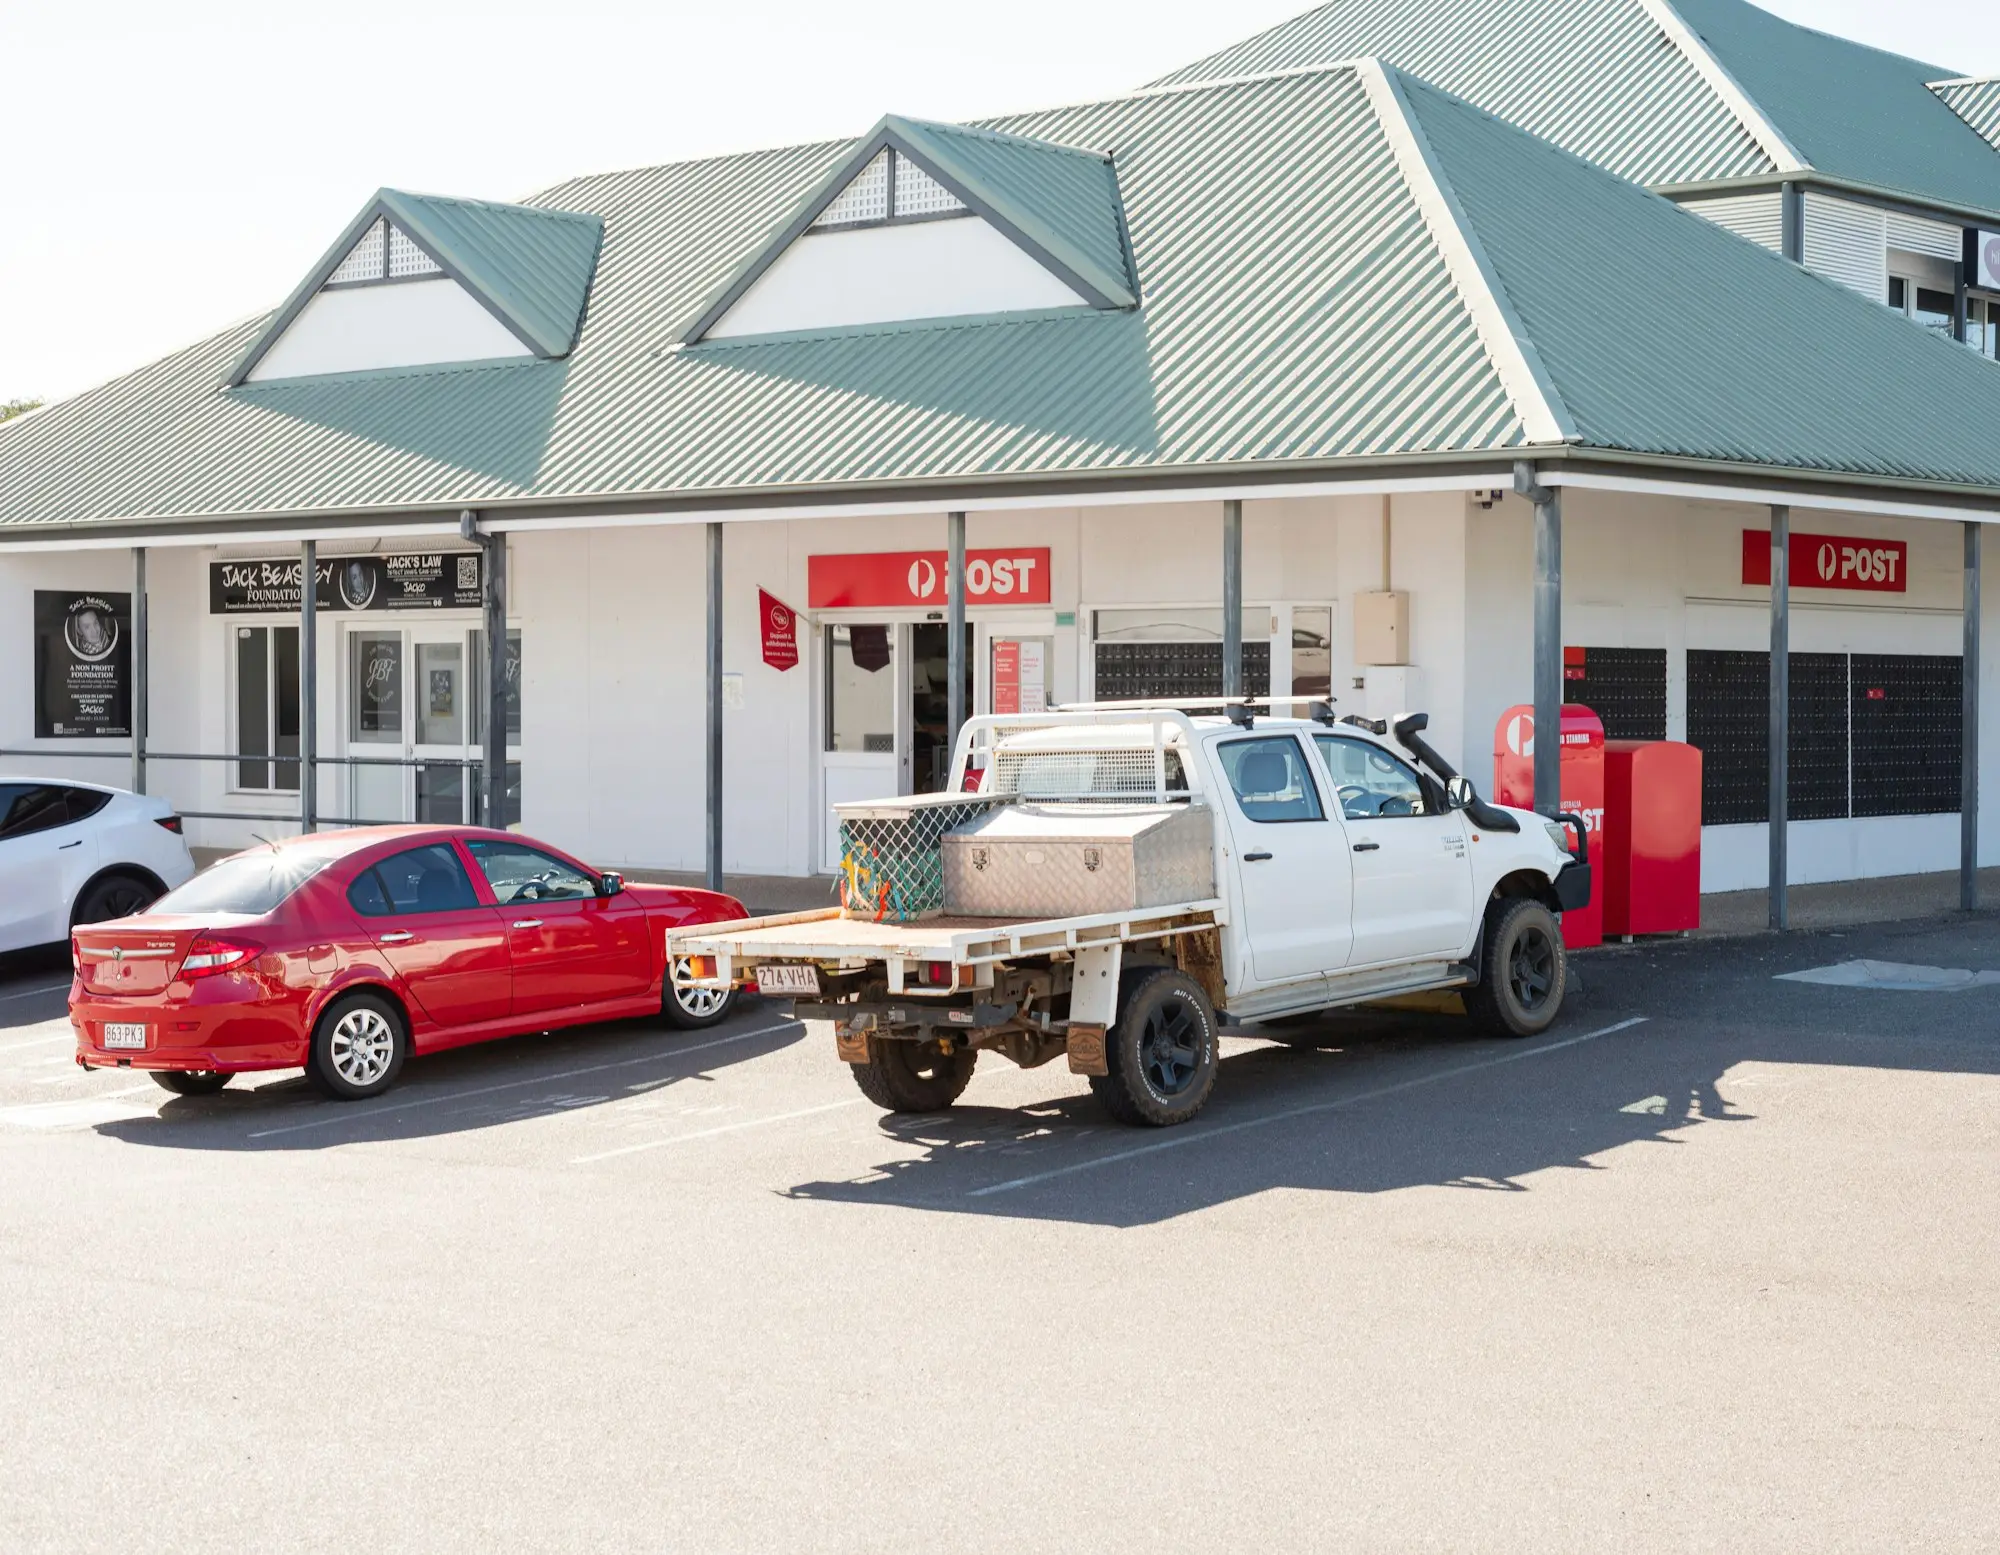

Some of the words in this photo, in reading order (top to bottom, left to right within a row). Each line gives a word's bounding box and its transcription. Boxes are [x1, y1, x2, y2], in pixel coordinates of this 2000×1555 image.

[386, 556, 420, 569] JACK'S
[421, 555, 442, 568] LAW
[1841, 546, 1900, 583] POST
[221, 565, 258, 590] JACK
[261, 562, 334, 587] BEASEY
[944, 558, 1036, 595] OST
[247, 588, 302, 602] FOUNDATIO
[403, 581, 426, 594] JACKO
[80, 704, 104, 714] JACKO
[1560, 808, 1605, 833] OST
